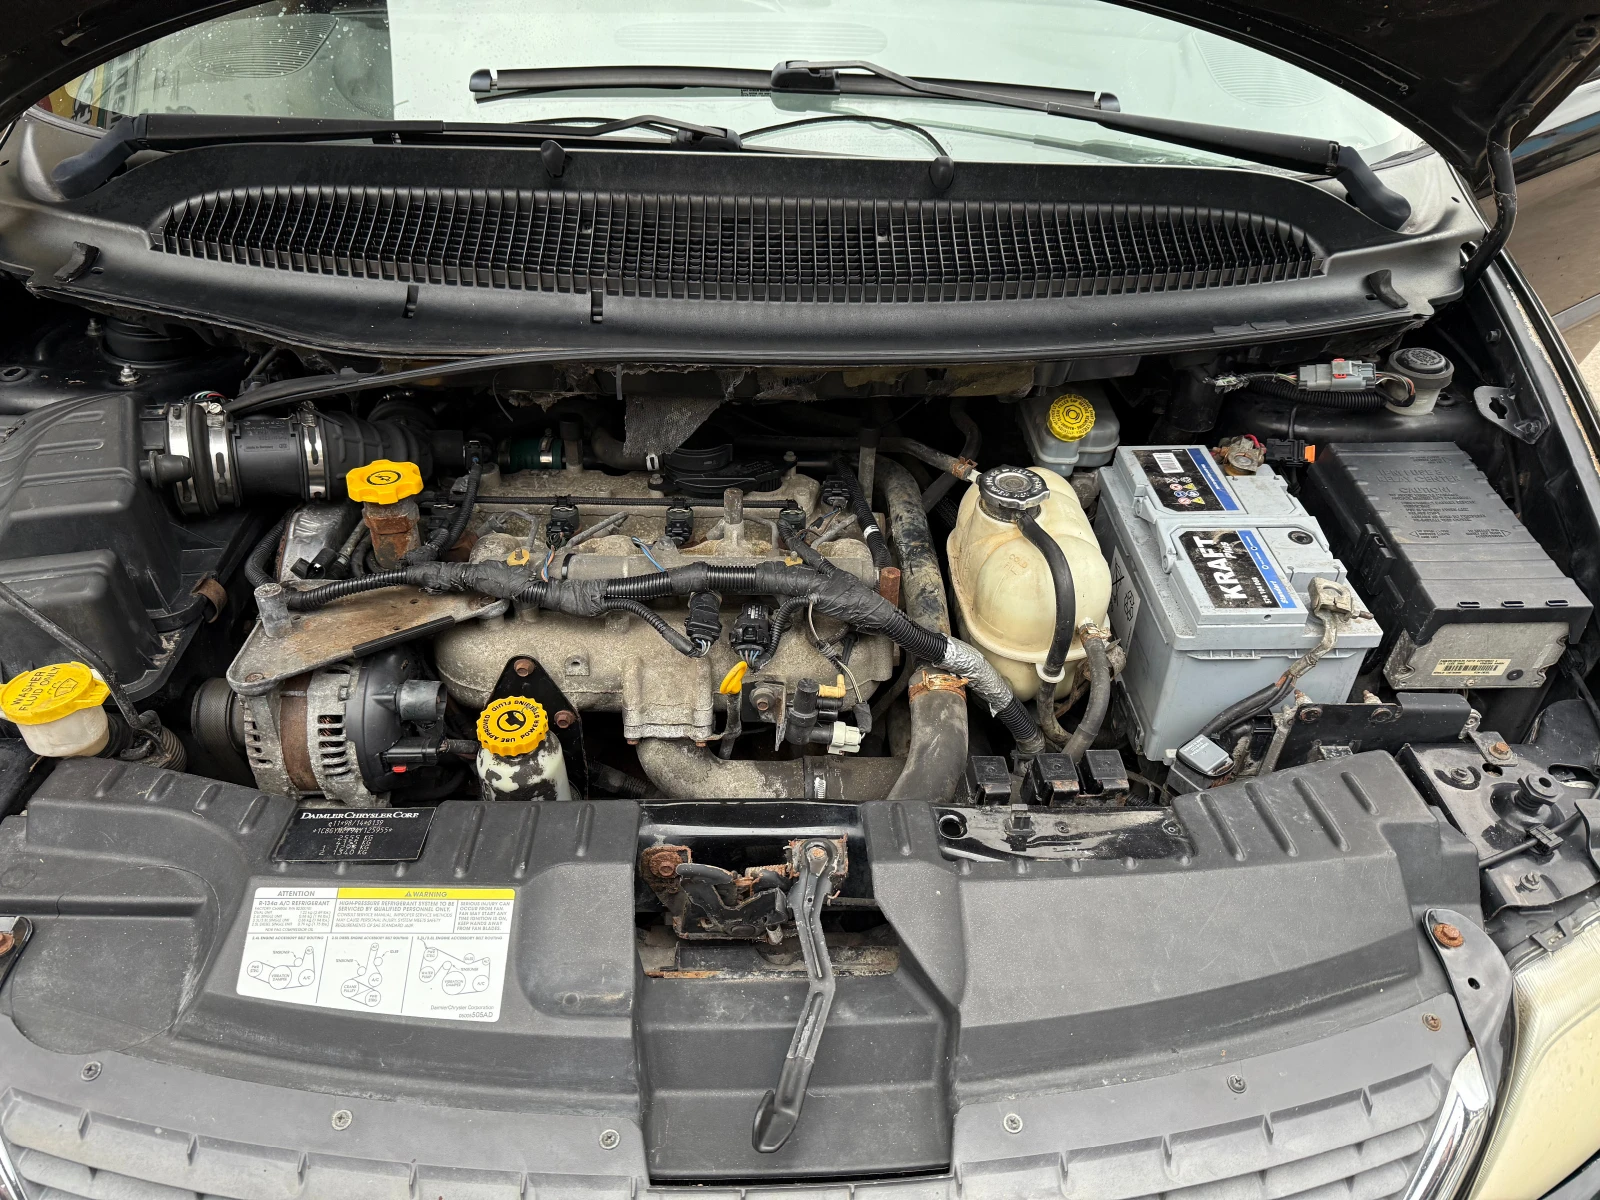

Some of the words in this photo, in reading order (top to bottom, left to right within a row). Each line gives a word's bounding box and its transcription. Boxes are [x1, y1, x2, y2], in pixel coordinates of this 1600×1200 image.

[1220, 541, 1237, 559] Plus
[1193, 536, 1248, 599] KRAFT
[10, 672, 46, 706] WASHER
[18, 688, 44, 711] FLUID
[40, 666, 61, 686] ONLY
[492, 700, 512, 712] FLUID
[514, 700, 540, 719] STEERING
[482, 714, 500, 740] APPROVED
[520, 720, 539, 740] POWER
